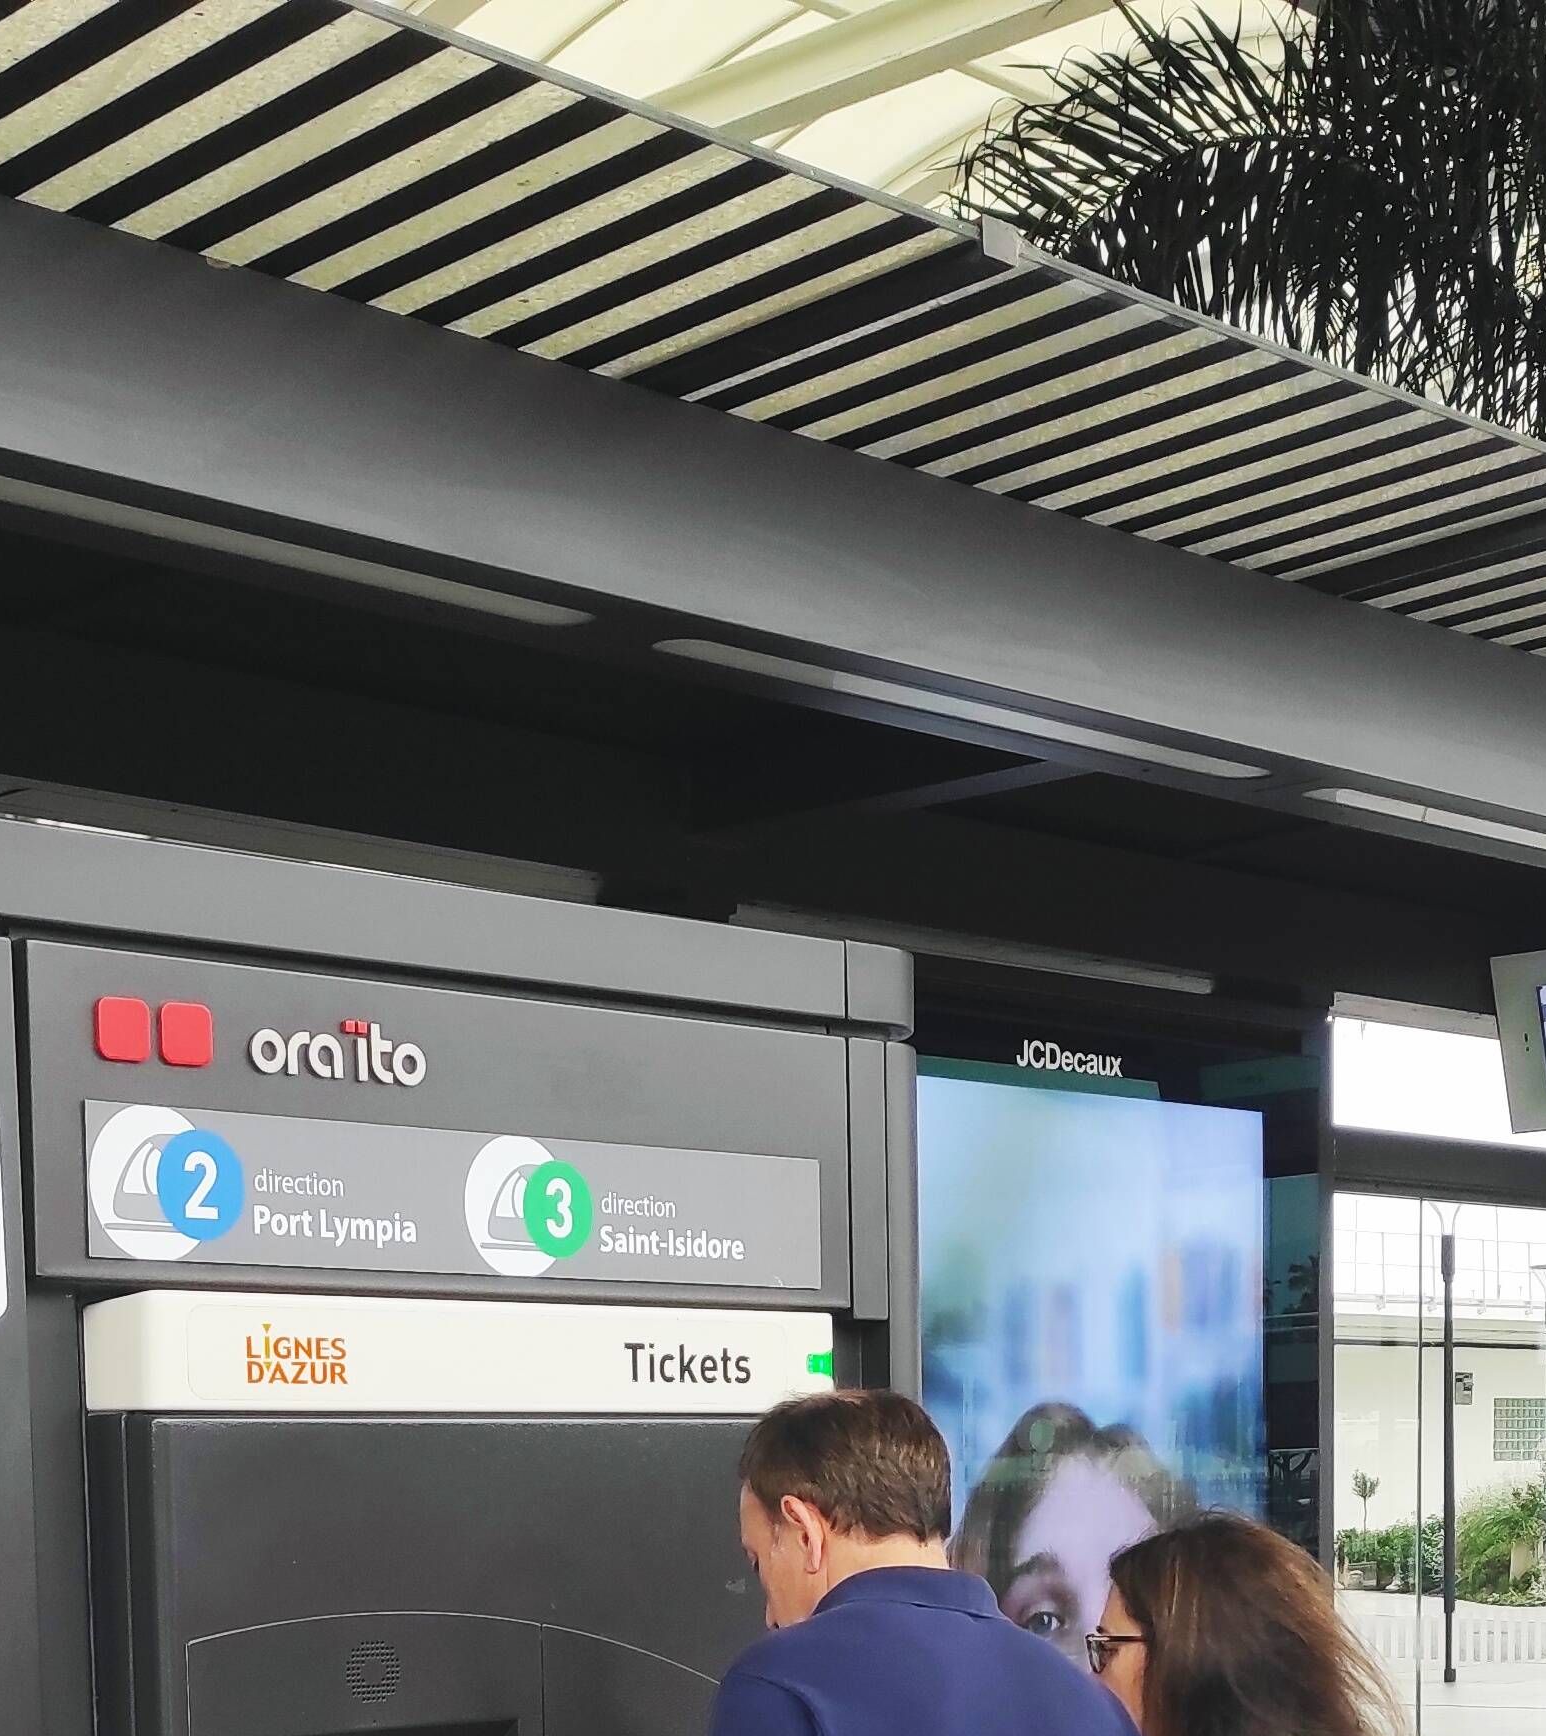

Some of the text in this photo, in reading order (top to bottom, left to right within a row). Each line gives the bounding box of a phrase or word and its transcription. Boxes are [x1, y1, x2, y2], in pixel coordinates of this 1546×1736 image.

[1016, 1040, 1123, 1077] JCDecaux
[183, 1151, 218, 1219] 2
[254, 1168, 344, 1197] direction
[545, 1177, 573, 1238] 3
[601, 1192, 676, 1218] direction
[254, 1205, 417, 1248] Port Lympia
[600, 1226, 745, 1259] Saint-Isidore
[246, 1324, 346, 1360] LIGNES
[247, 1361, 348, 1384] D'AZUR
[625, 1343, 751, 1383] Tickets
